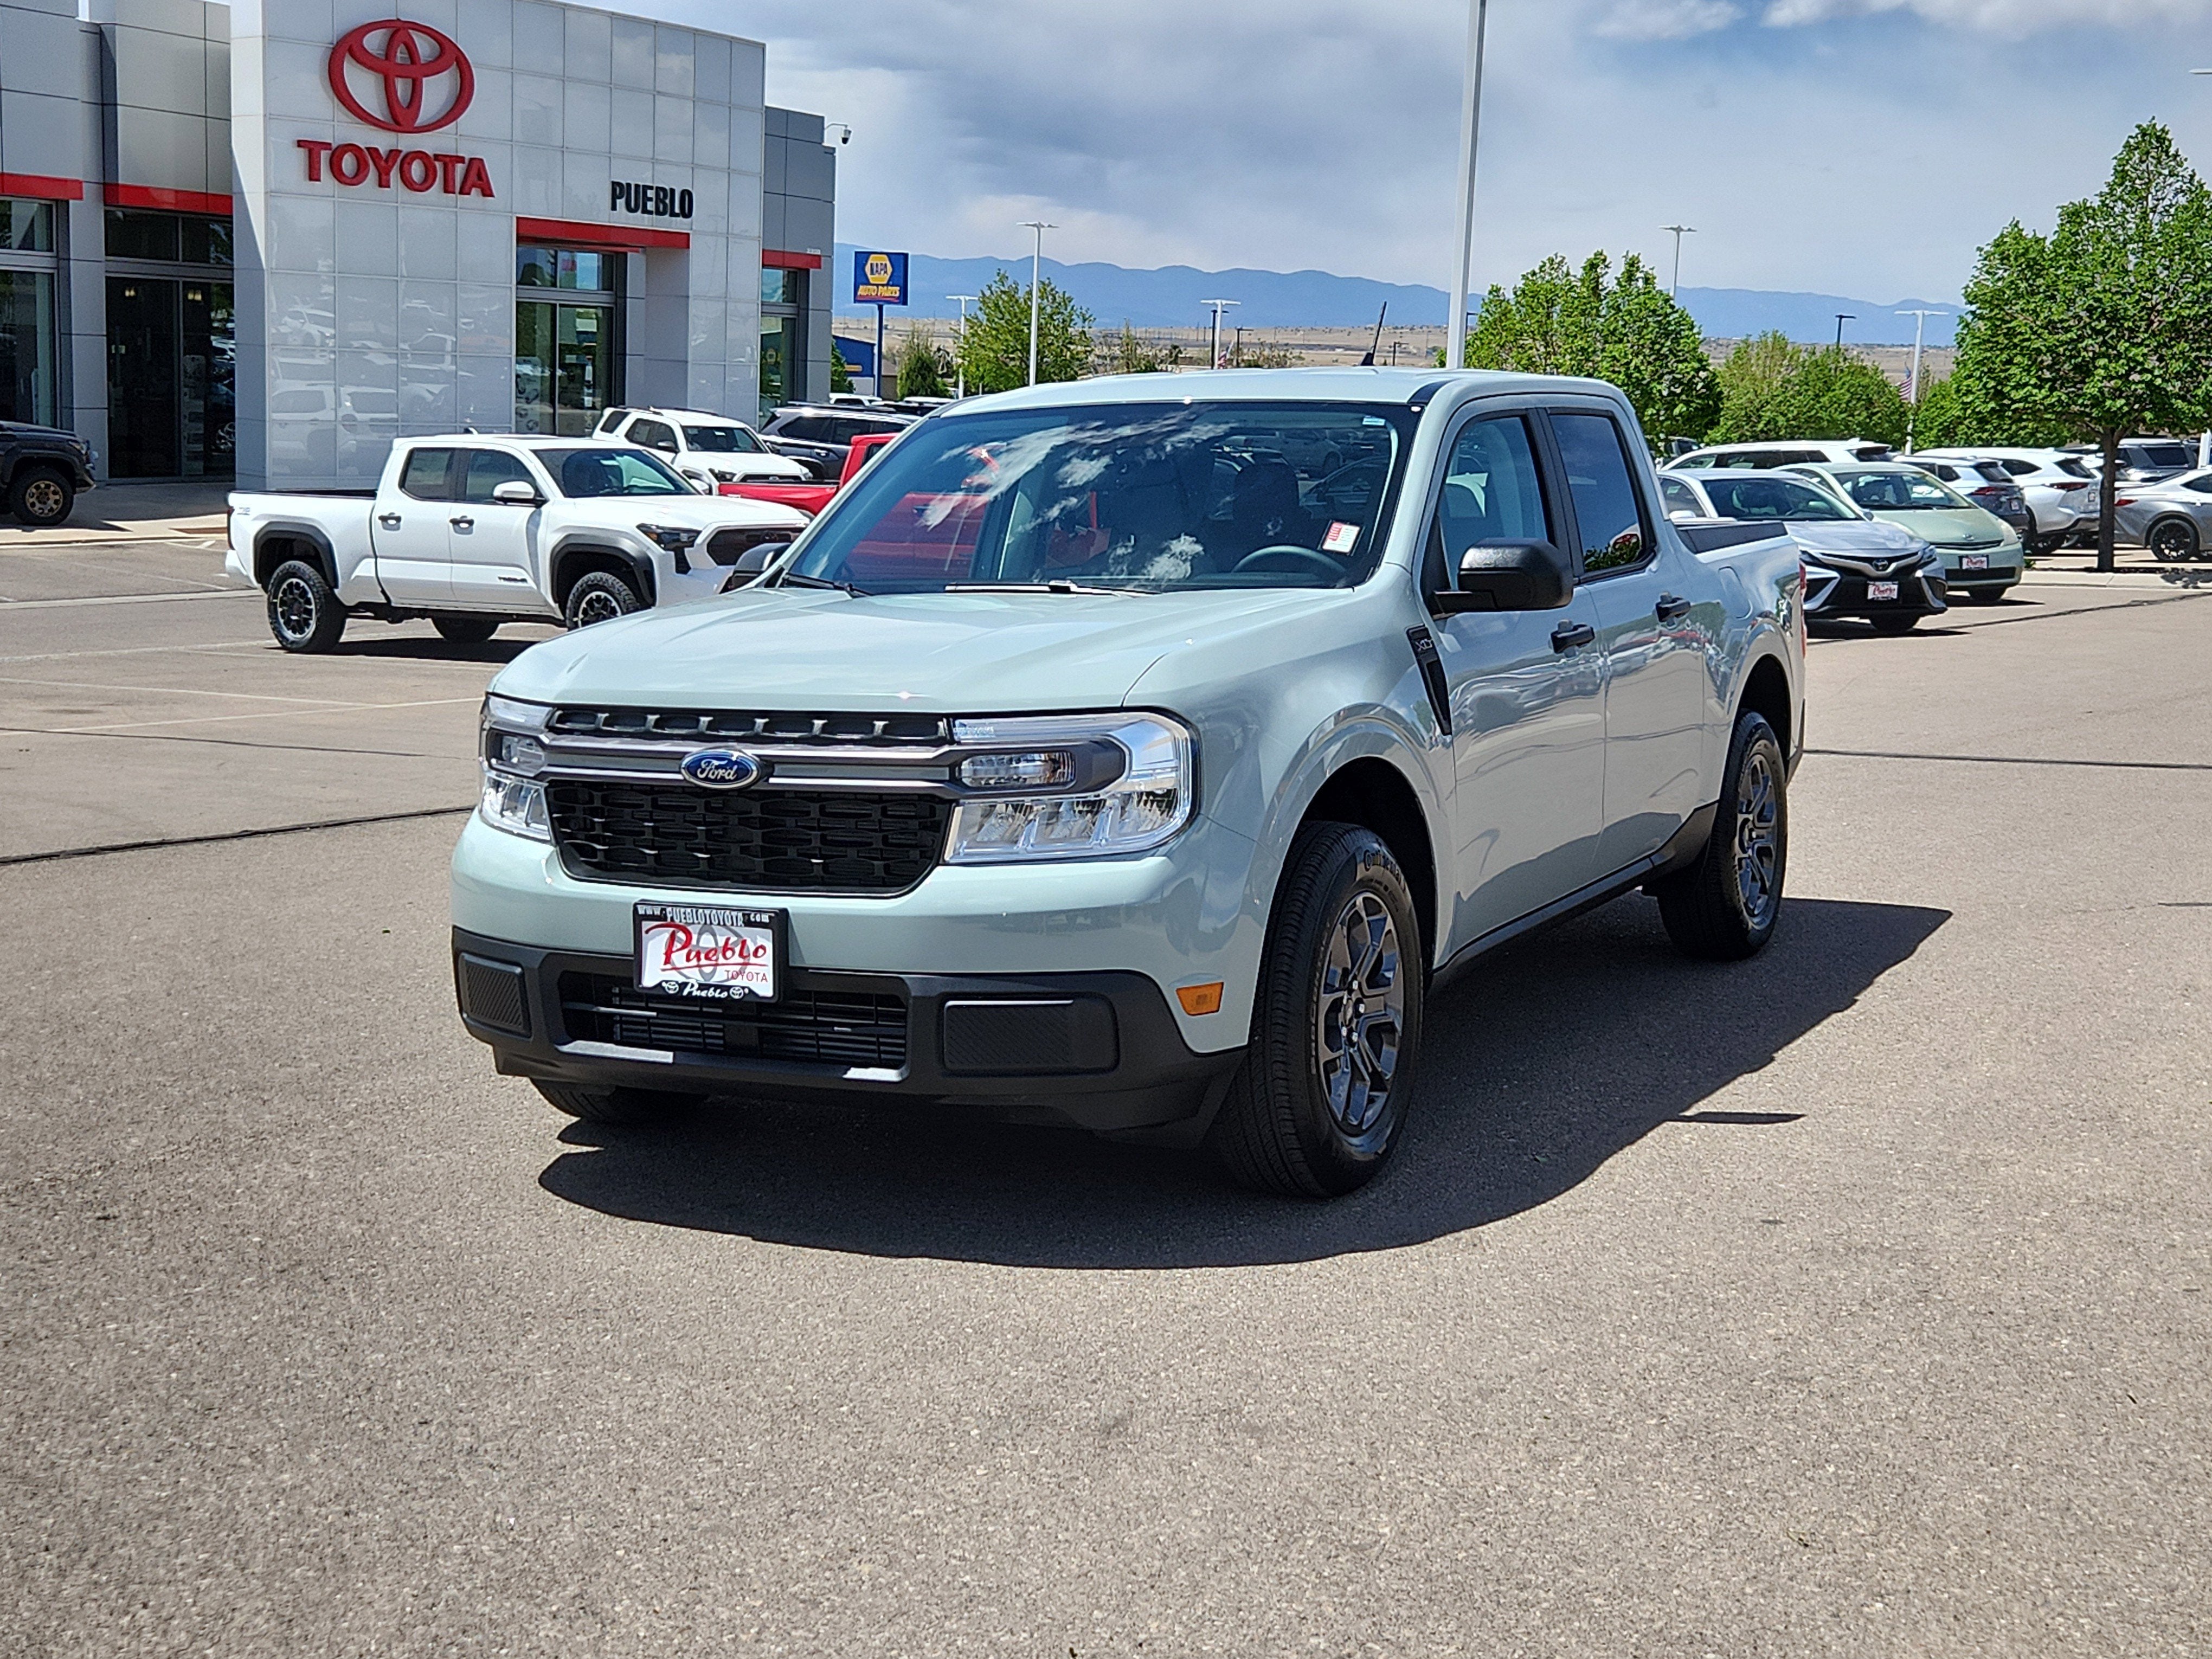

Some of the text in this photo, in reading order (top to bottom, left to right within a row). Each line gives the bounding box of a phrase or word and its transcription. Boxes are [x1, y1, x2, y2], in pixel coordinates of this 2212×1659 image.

[297, 139, 494, 197] TOYOTA
[611, 181, 693, 218] PUEBLO
[870, 262, 888, 275] NAPA
[857, 285, 900, 297] AUTO PARTS
[697, 759, 737, 780] Ford
[645, 922, 767, 966] Pueblo
[725, 969, 768, 982] TOYOTA
[682, 980, 728, 998] Pueblo
